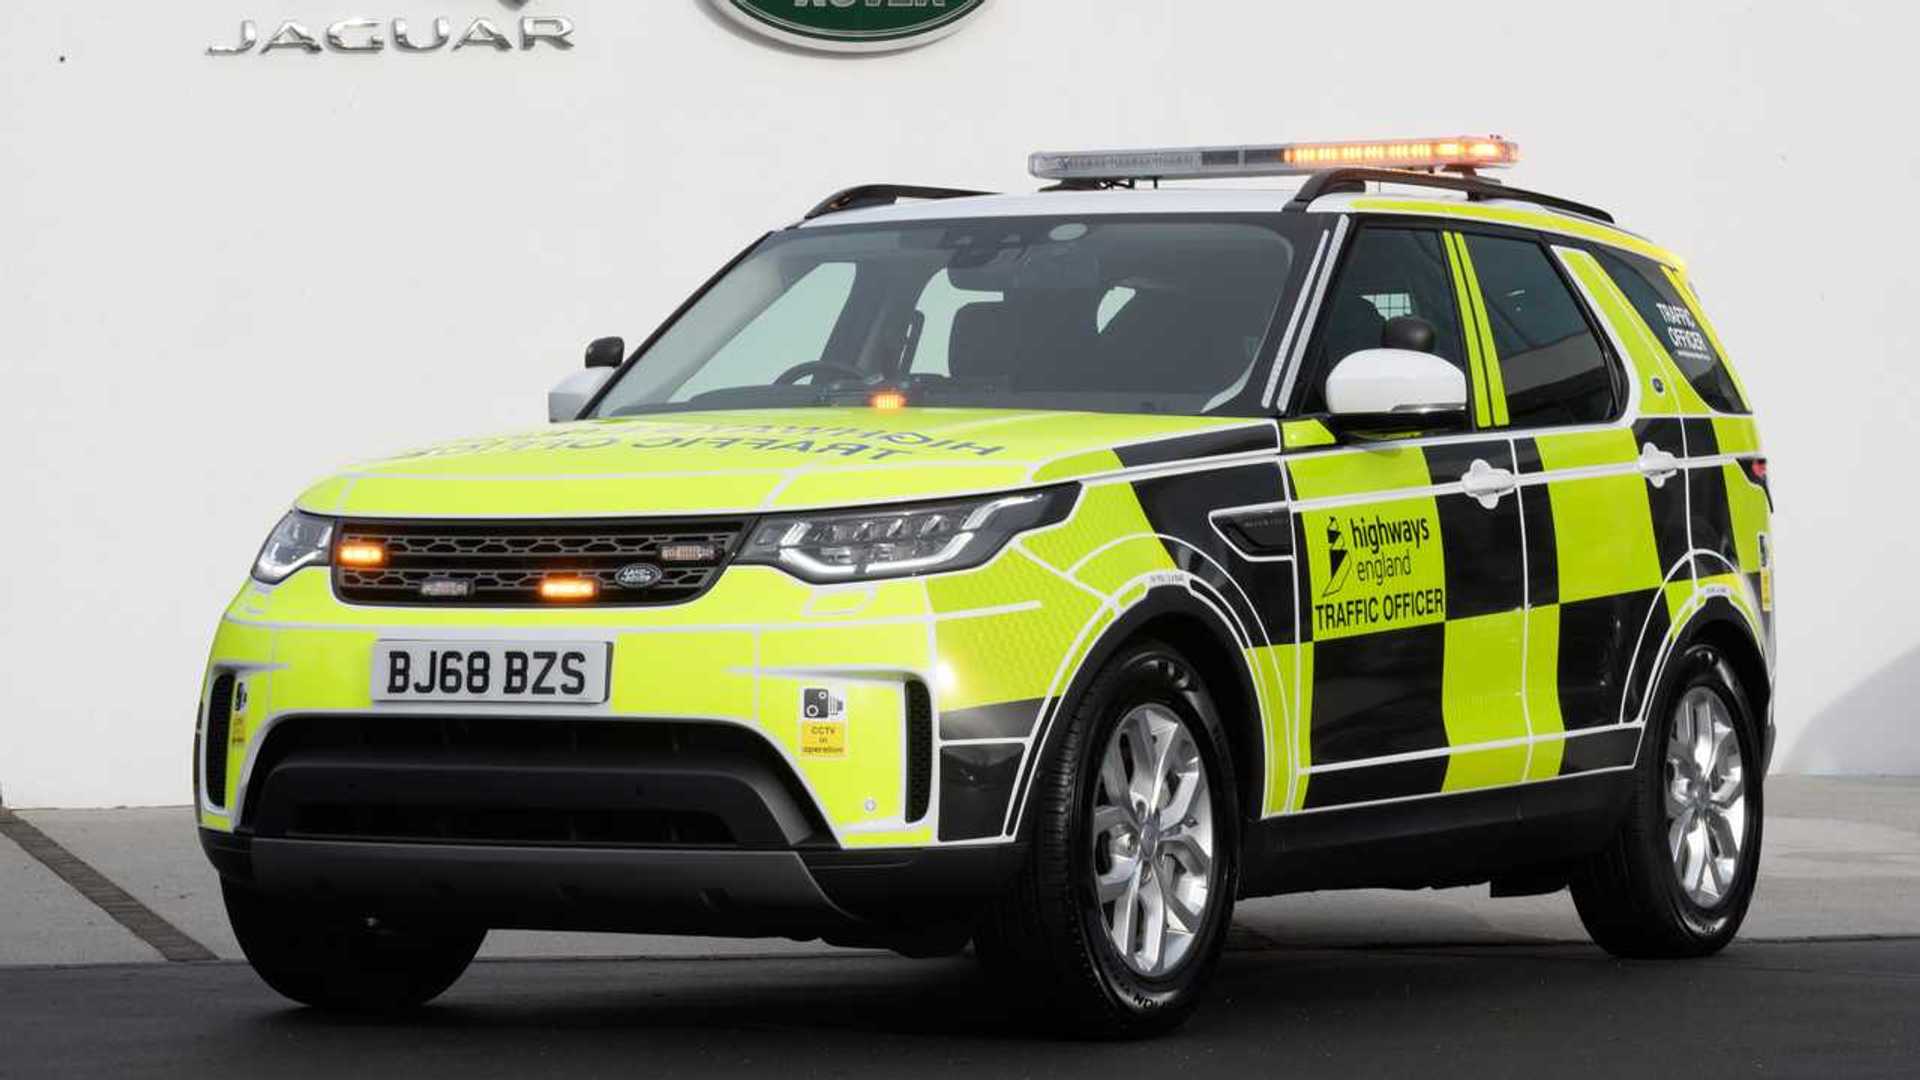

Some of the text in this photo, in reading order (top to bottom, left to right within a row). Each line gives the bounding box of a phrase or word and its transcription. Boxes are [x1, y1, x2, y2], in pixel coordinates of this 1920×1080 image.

[205, 17, 575, 56] JAGUAR
[1350, 515, 1430, 554] highways
[1357, 549, 1412, 586] england
[1315, 588, 1444, 631] TRAFFIC OFFICER
[387, 650, 586, 695] BJ68 BZS
